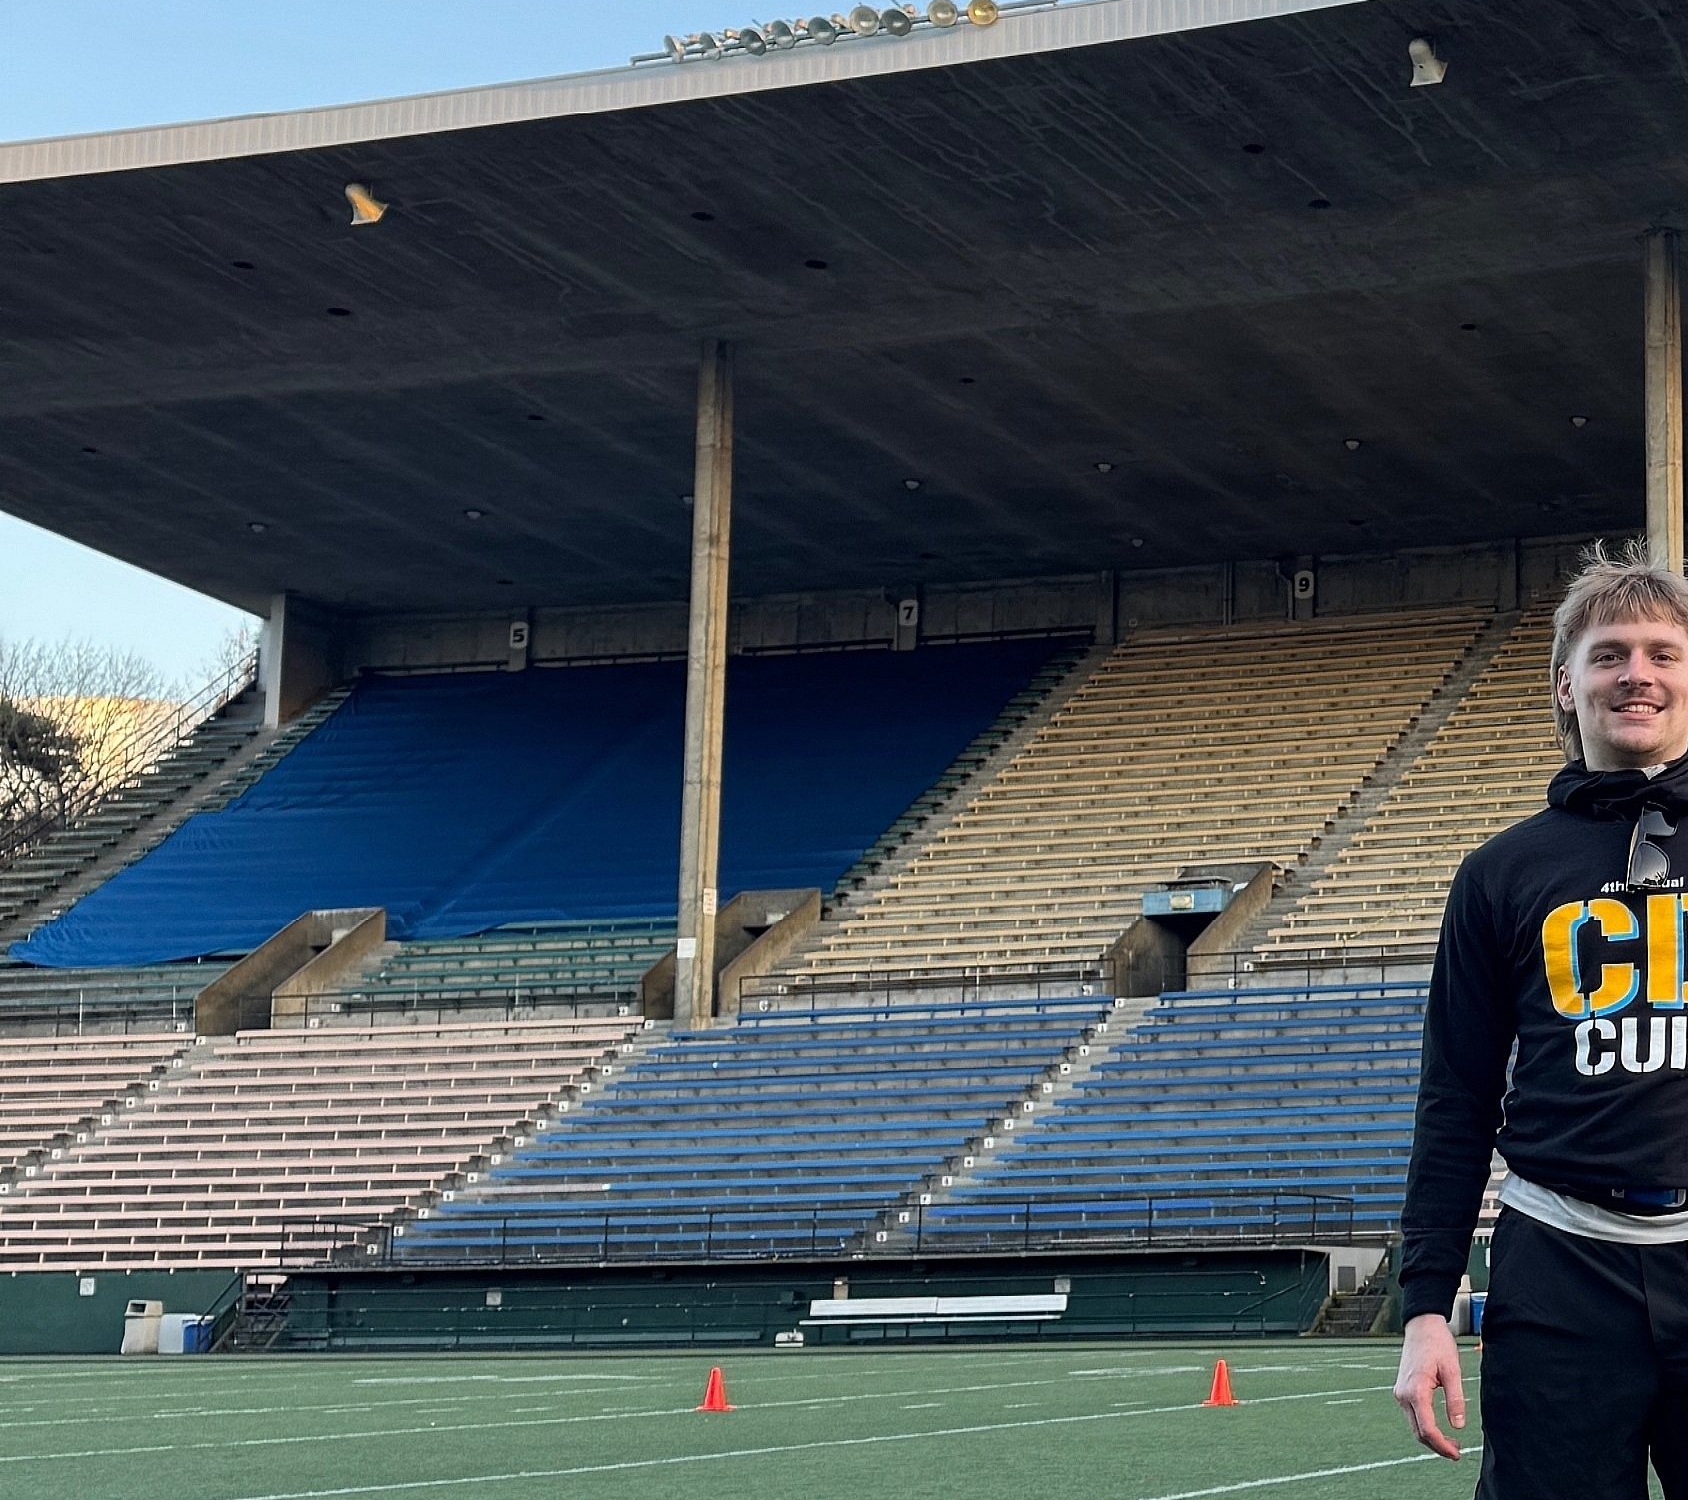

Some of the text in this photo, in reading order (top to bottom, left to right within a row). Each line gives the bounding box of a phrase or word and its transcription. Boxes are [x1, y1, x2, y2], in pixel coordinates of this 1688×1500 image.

[1298, 577, 1310, 592] 9
[903, 606, 914, 621] 7
[512, 628, 525, 642] 5
[1600, 880, 1625, 893] 4th
